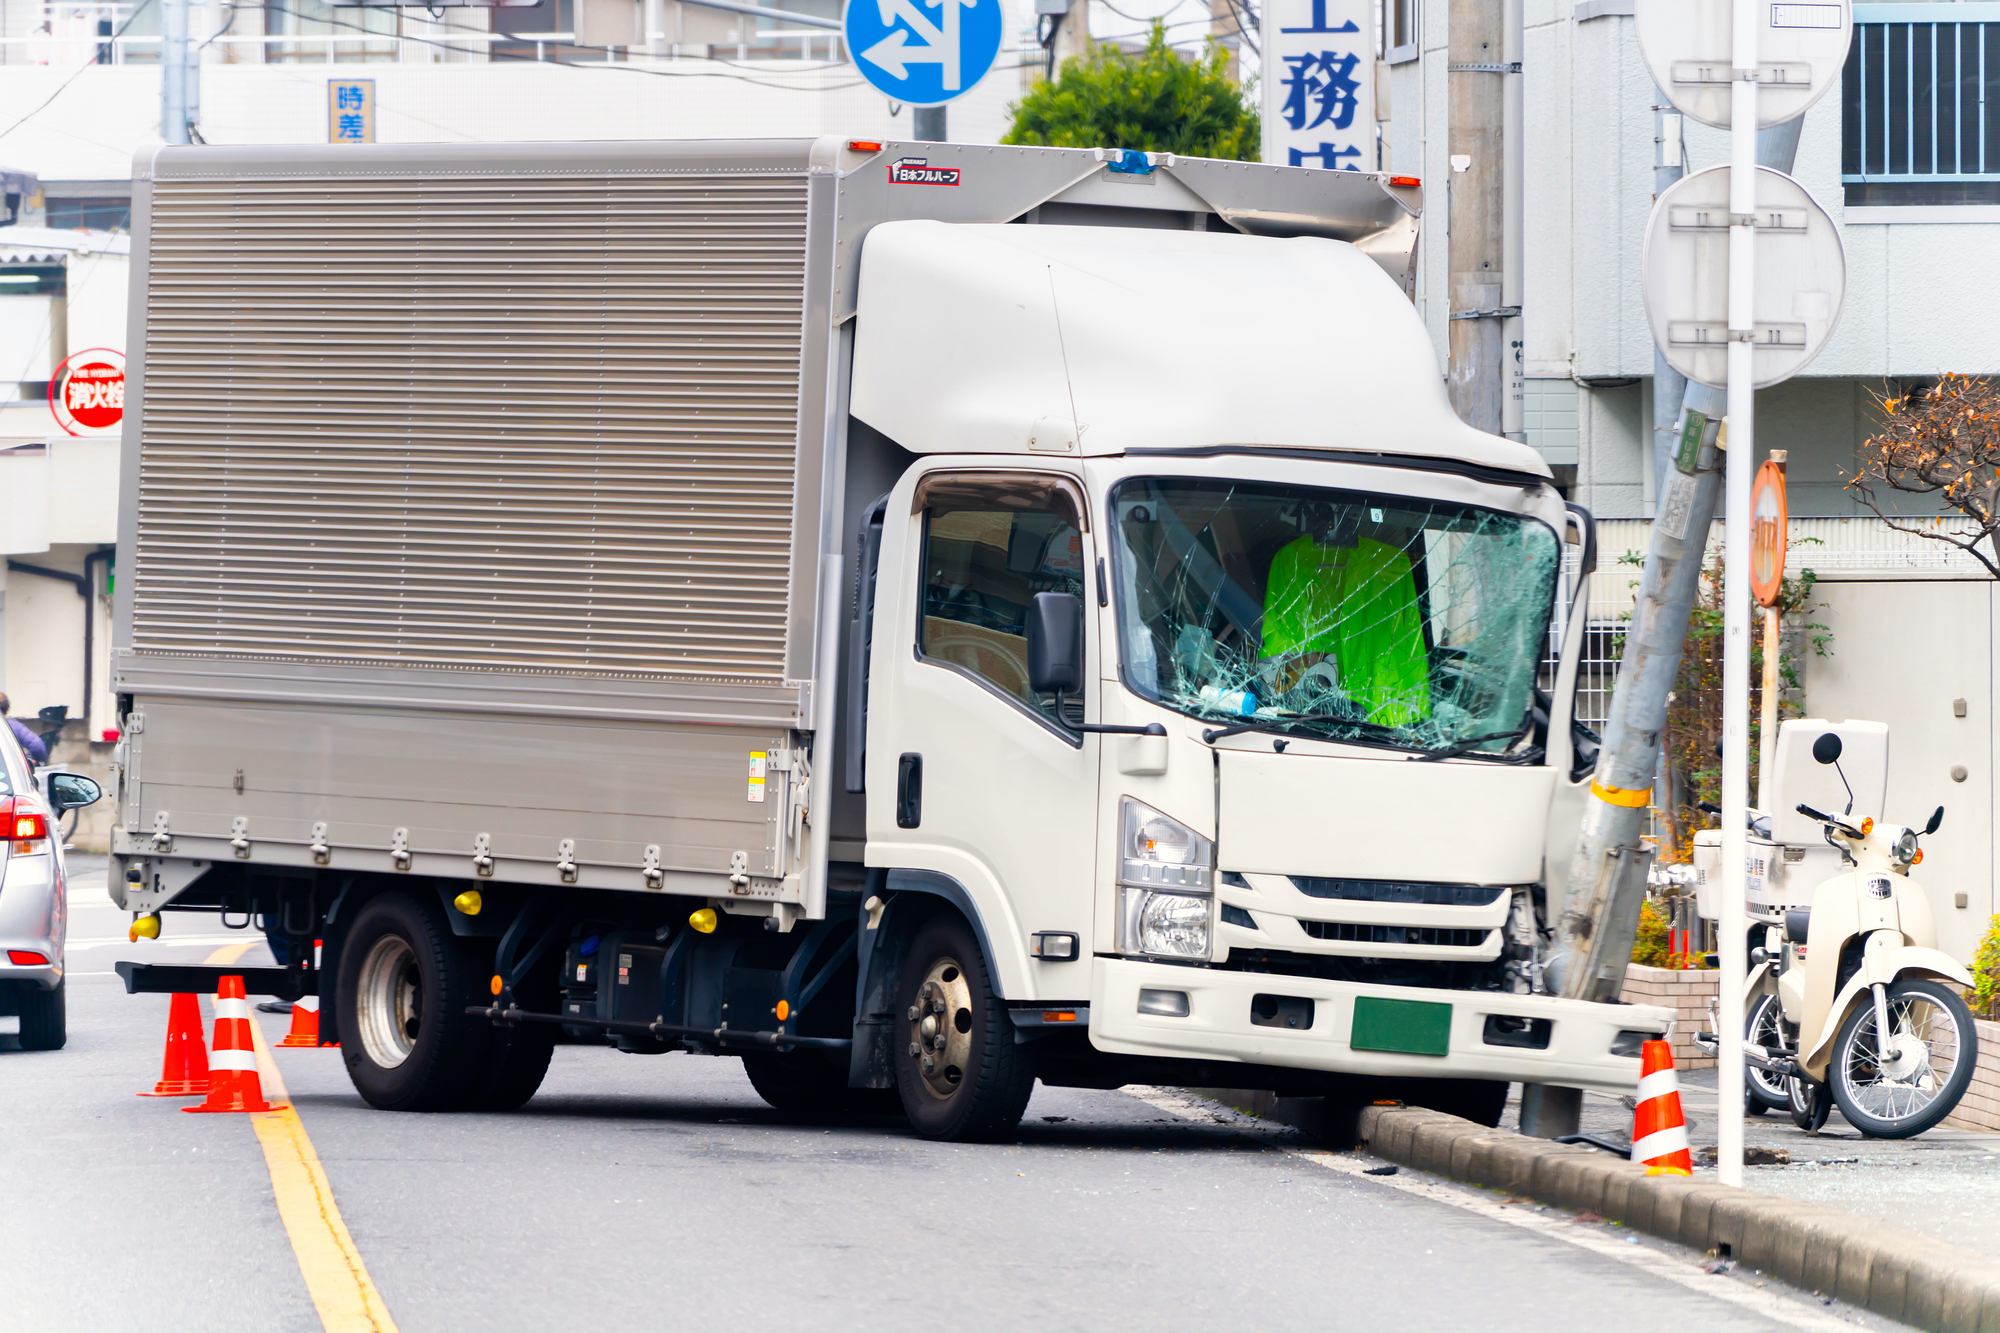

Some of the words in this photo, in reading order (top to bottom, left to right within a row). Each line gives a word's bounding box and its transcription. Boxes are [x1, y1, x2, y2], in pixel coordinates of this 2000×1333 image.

[337, 85, 365, 143] 時差
[900, 169, 959, 182] 日本フルハーフ
[68, 379, 124, 409] 消火栓
